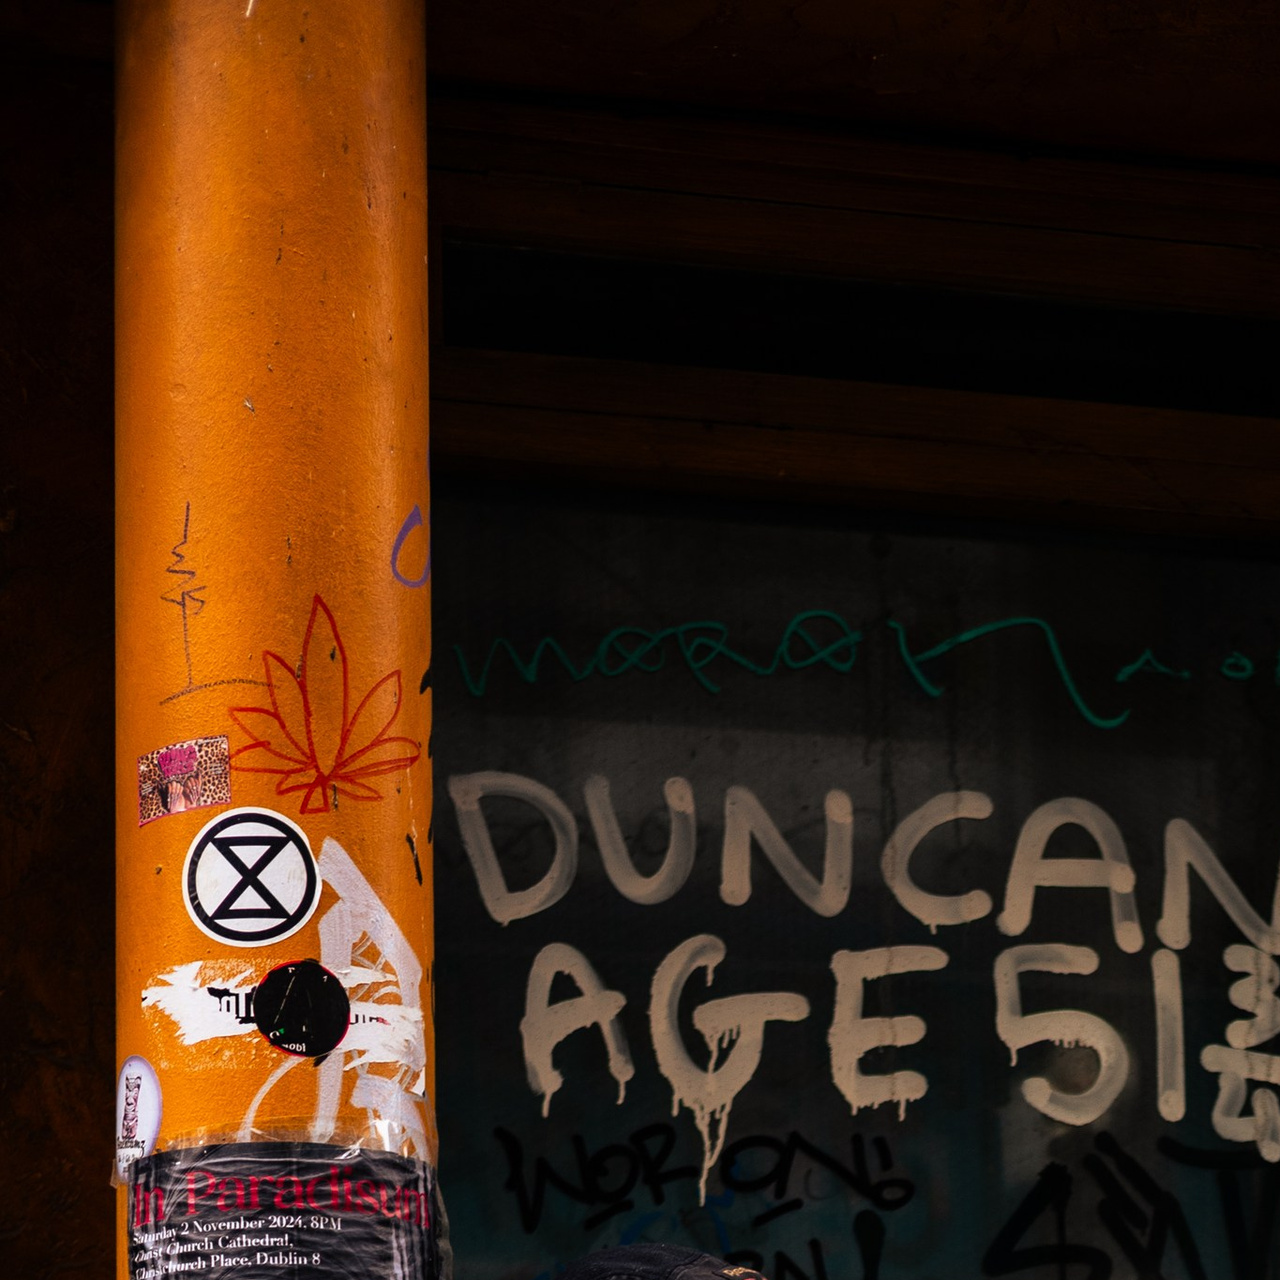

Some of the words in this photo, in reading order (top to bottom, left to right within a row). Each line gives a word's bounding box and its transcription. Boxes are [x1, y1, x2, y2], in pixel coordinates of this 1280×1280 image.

[520, 933, 950, 1135] AGE
[132, 1184, 166, 1229] In
[187, 1166, 430, 1230] Paradisum
[133, 1228, 177, 1246] Saturday
[181, 1223, 189, 1236] 2
[193, 1216, 265, 1234] November
[311, 1215, 342, 1231] 8PM
[135, 1248, 162, 1263] Christ
[167, 1236, 213, 1256] Church
[218, 1233, 294, 1249] Cathedral,
[135, 1256, 206, 1280] Christchurch
[257, 1251, 308, 1266] Dublin
[312, 1252, 321, 1266] 8
